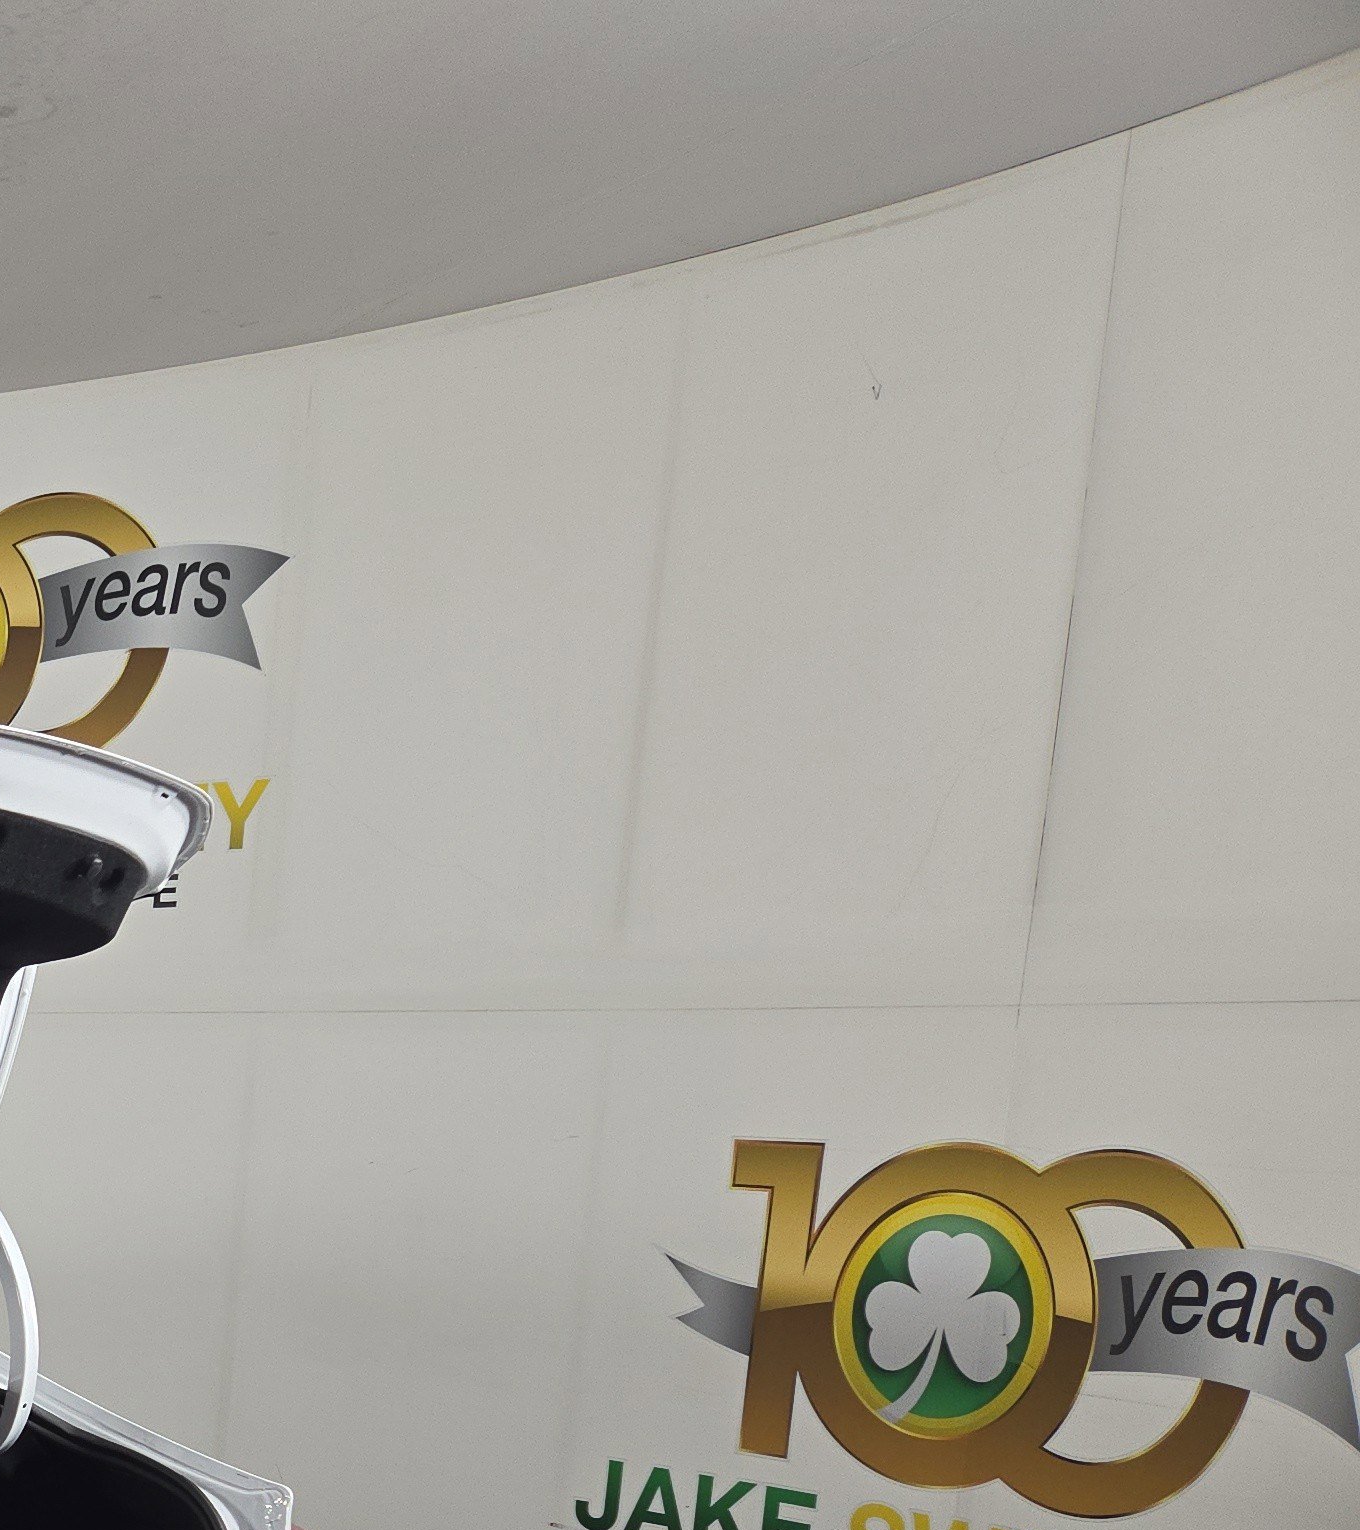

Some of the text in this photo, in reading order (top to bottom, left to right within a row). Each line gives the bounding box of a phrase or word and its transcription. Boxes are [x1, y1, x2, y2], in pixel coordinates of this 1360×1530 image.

[54, 558, 231, 648] years
[730, 1139, 1335, 1520] 100 years
